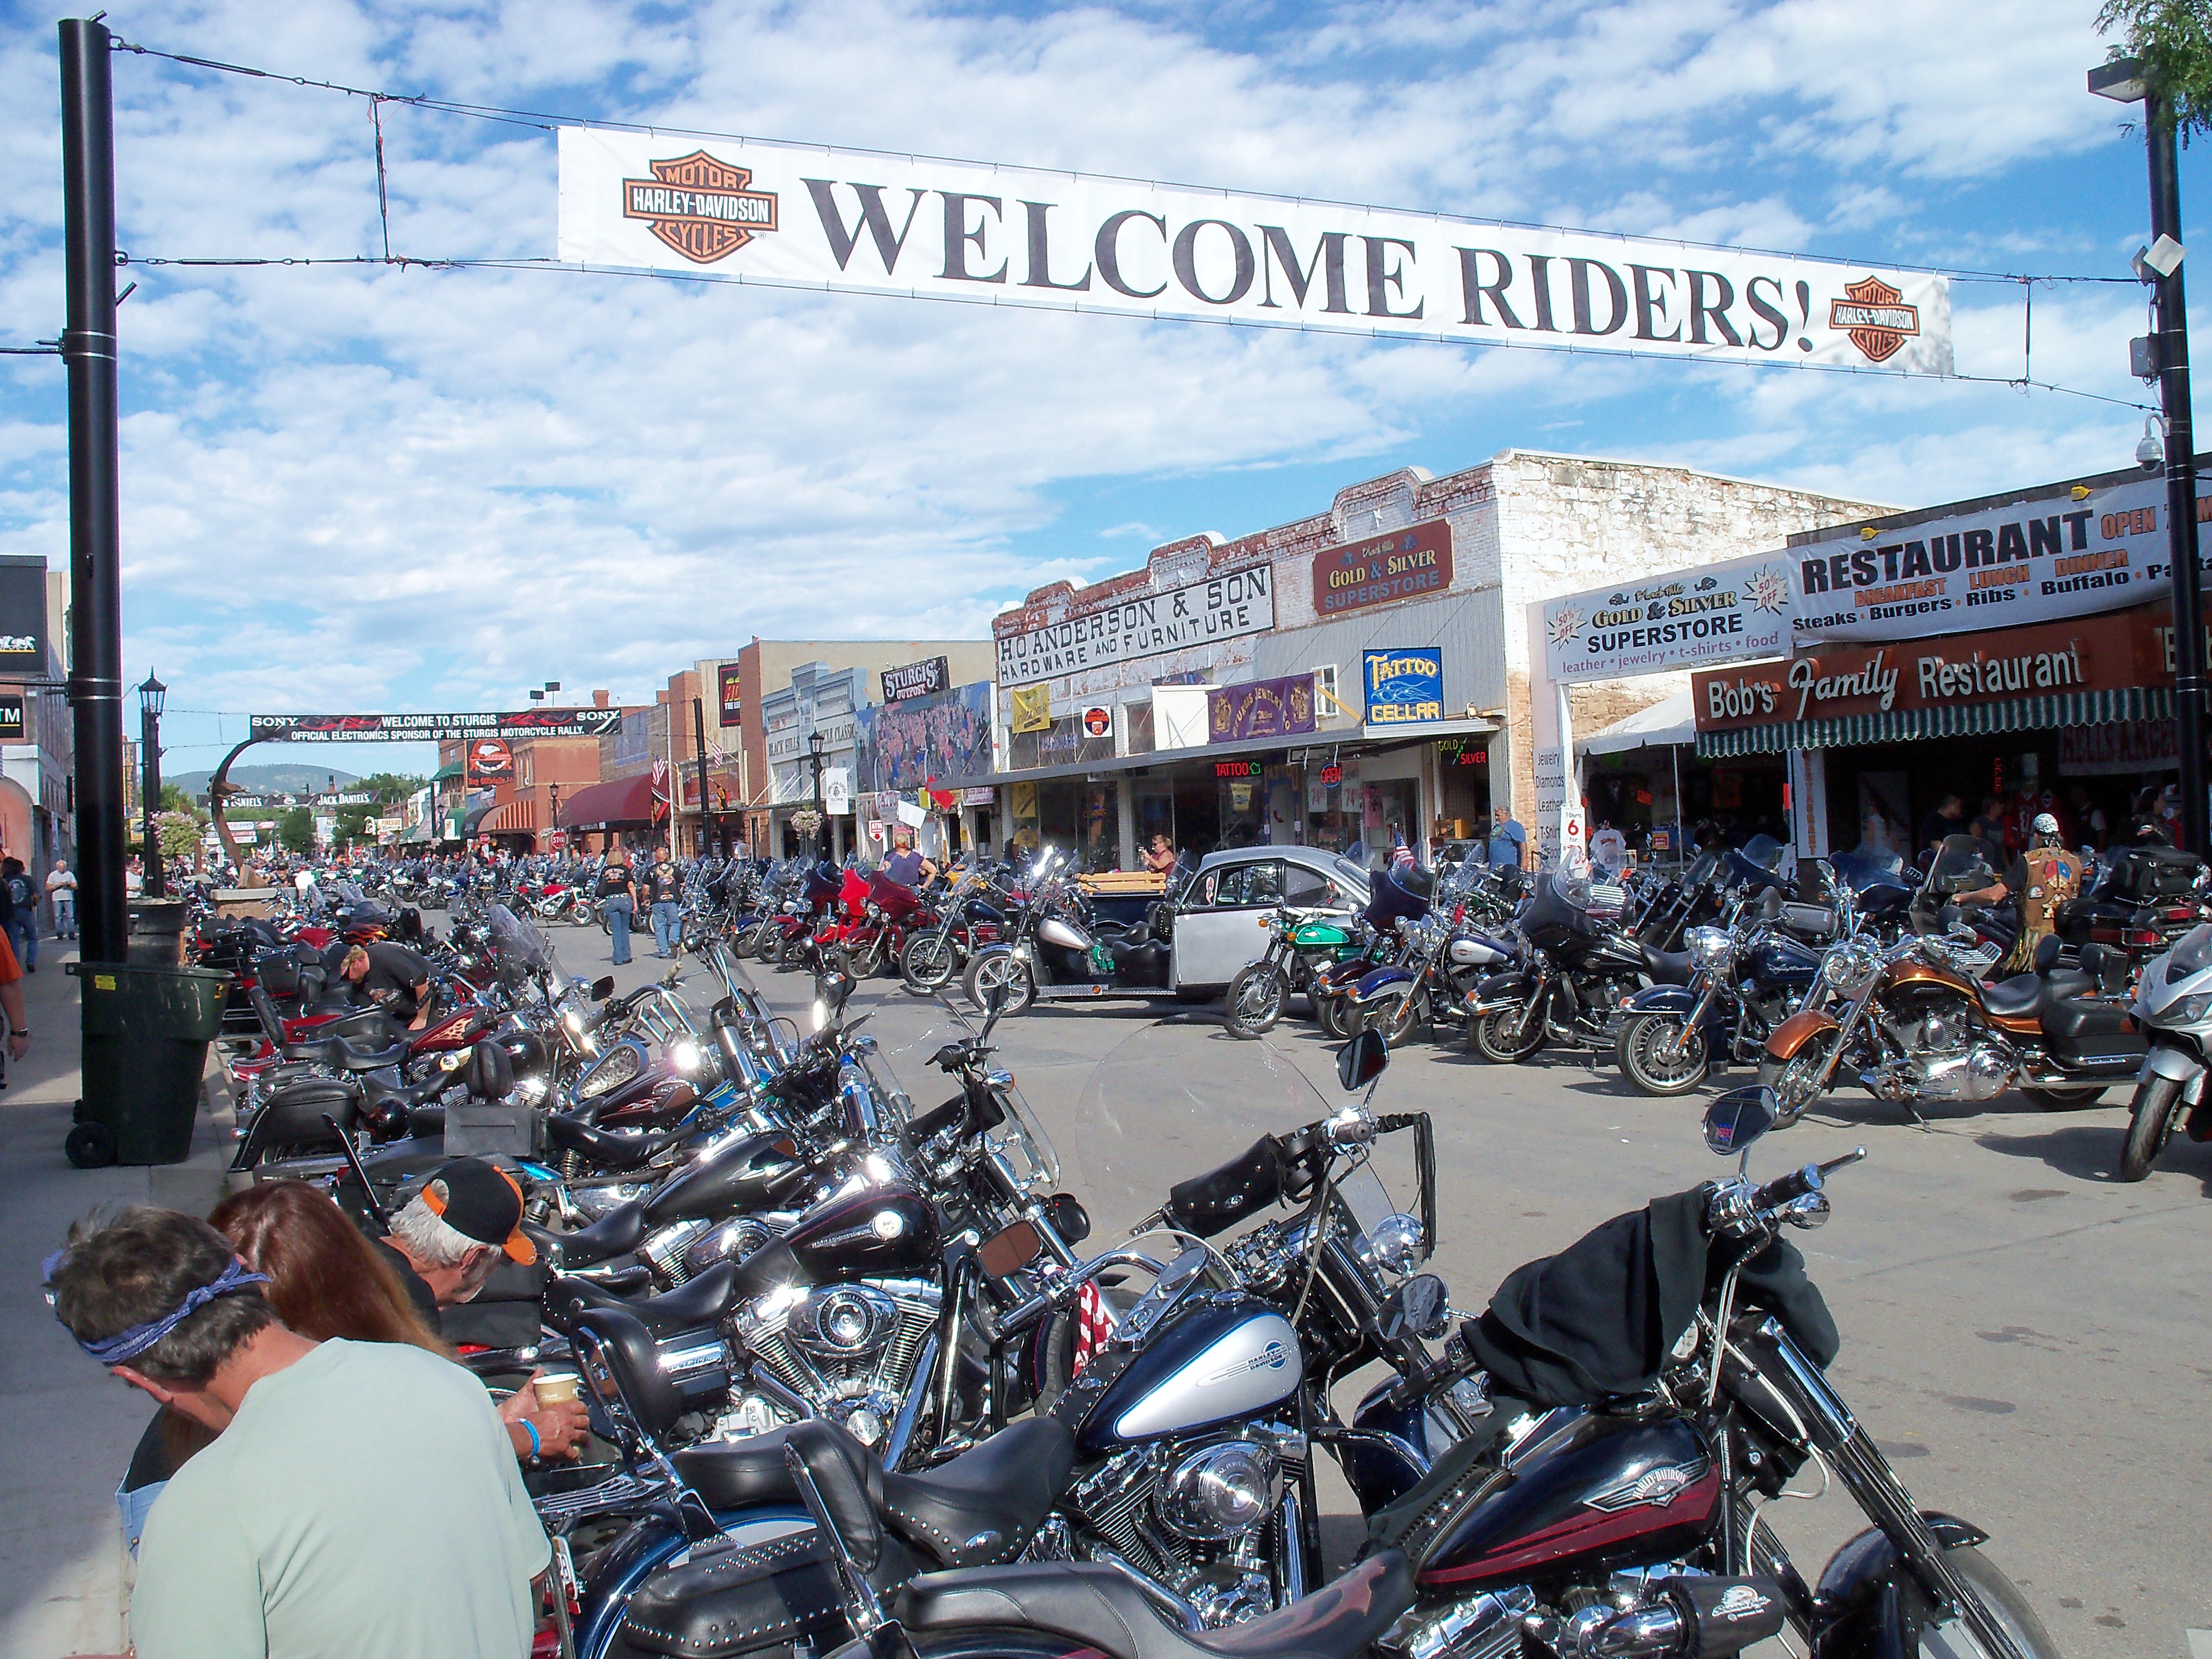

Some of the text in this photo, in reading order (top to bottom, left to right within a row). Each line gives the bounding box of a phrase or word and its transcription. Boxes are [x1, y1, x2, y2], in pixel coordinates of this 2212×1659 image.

[666, 162, 738, 188] MOTOR
[633, 188, 769, 222] HARLEY-DAVIDSON
[664, 221, 738, 256] CYCLES
[800, 178, 1813, 352] WELCOME RIDERS!
[1855, 283, 1895, 304] MOTOR
[1835, 305, 1914, 330] HARLEY-DAVIDSON
[1857, 328, 1895, 355] CYCLES
[1802, 510, 2094, 595] RESTAURANT
[2101, 506, 2156, 540] OPEN
[1329, 549, 1436, 589] GOLD & SILVER
[1854, 549, 2129, 608] BREAKFAST LUNCH DINNER
[1173, 591, 1190, 618] &
[1207, 567, 1266, 610] SON
[1325, 570, 1439, 609] SUPERSTORE
[1758, 576, 1778, 593] 50%
[1592, 590, 1738, 628] GOLD & SILVER
[1760, 589, 1777, 608] OFF
[1792, 610, 1857, 630] Steaks
[1870, 598, 1951, 621] Burgers
[1966, 586, 2016, 607] Ribs
[2041, 571, 2129, 595] Buffalo
[1558, 610, 1574, 625] 50%
[1001, 605, 1250, 681] HARDWARE AND FURNITURE
[1559, 624, 1573, 639] OFF
[1587, 613, 1743, 653] SUPERSTORE
[1563, 631, 1778, 673] leather jewelry t-shirts food
[885, 662, 936, 698] STURGIS
[1709, 678, 1775, 720] Bob's
[1788, 649, 1899, 720] Family
[1918, 639, 2085, 699] Restaurant
[896, 683, 926, 700] OUTPOST
[252, 710, 620, 727] SONY WELCOME TO STURGIS SONY
[1372, 702, 1439, 722] CELLAR
[291, 725, 584, 741] OFFICIAL ELECTRONICS SPONSOR OF THE STURGIS MOTORCYCLE RALLY.
[2119, 718, 2180, 760] ANGEL
[769, 741, 784, 756] BLACK
[785, 736, 799, 753] HILLS
[1438, 739, 1458, 751] GOLD
[1215, 763, 1249, 776] TATTOO
[1461, 752, 1486, 764] SILVER
[1537, 753, 1560, 767] Jewelry
[1321, 769, 1341, 783] OPEN
[1535, 775, 1564, 789] Diamonds
[317, 792, 370, 806] JACK DANIEL'S
[1568, 819, 1579, 836] 6
[1250, 1354, 1283, 1370] DAVIDSON
